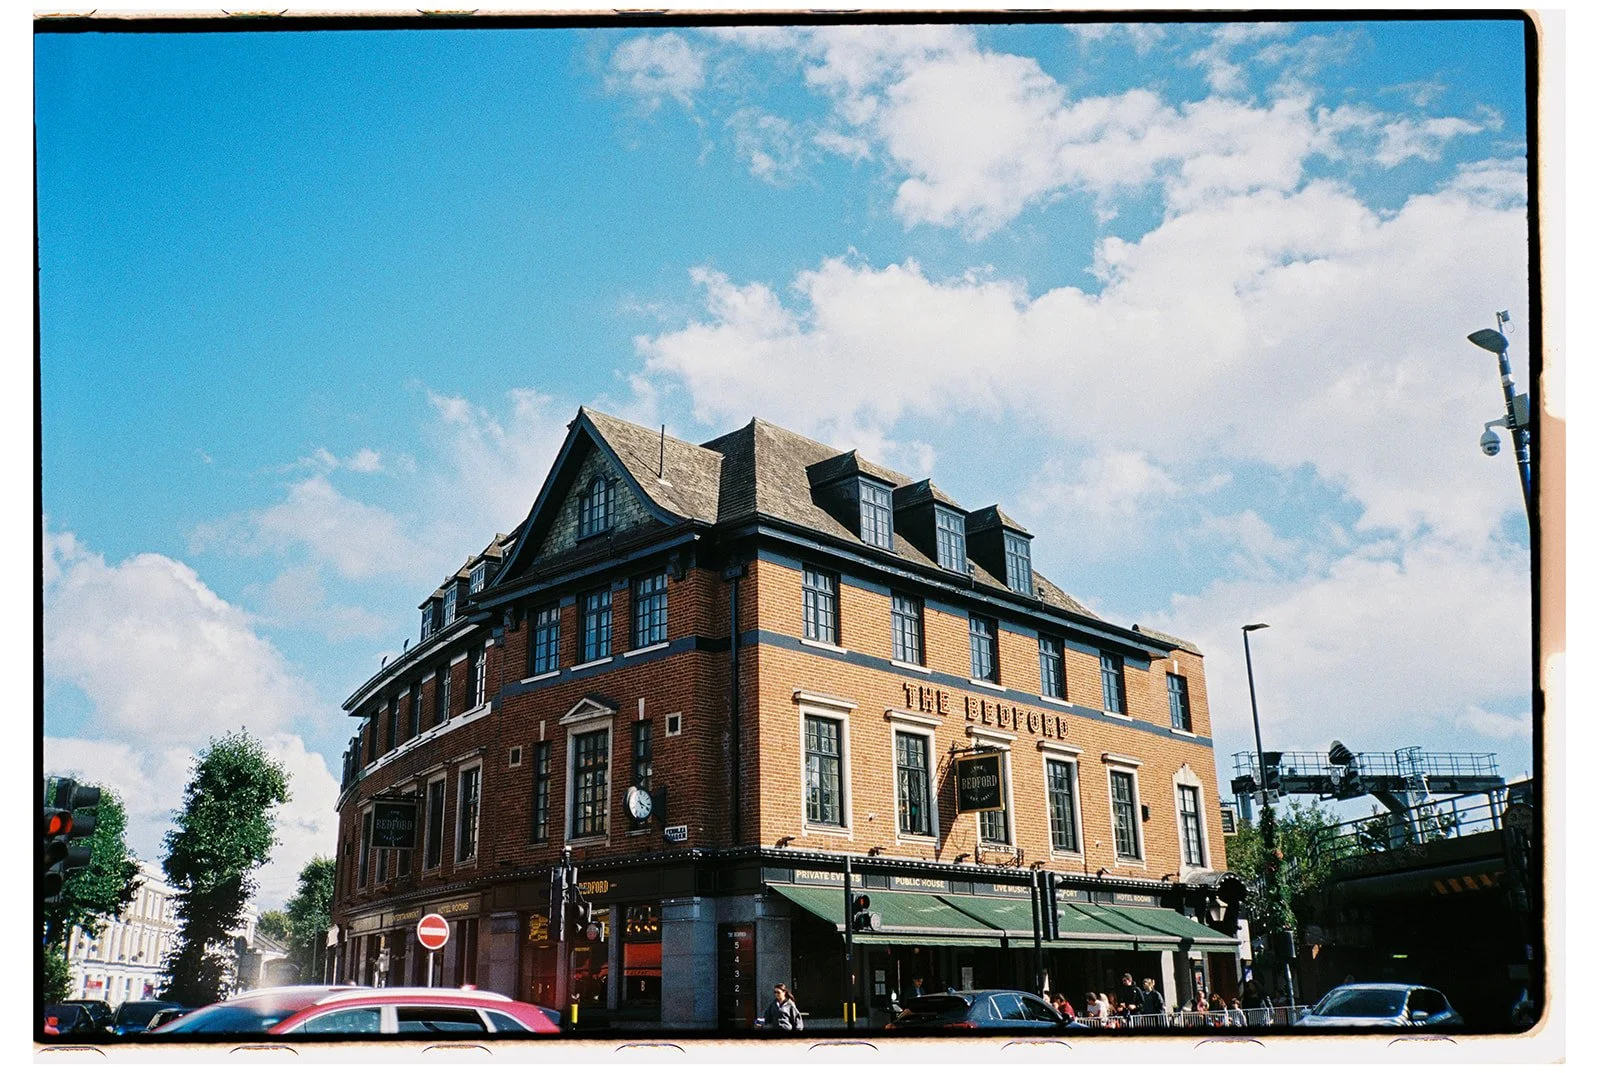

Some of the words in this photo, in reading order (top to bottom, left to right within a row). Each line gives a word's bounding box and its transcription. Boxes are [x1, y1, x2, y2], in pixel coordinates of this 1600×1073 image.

[903, 682, 950, 716] THE
[965, 696, 1069, 738] BEDFORD
[961, 775, 997, 790] BEDFORD
[376, 819, 413, 831] BEDFORD
[796, 870, 830, 881] PRIVATE
[830, 871, 861, 883] EVETS
[895, 876, 920, 887] PUBLIC
[921, 878, 945, 889] HOUSE
[578, 880, 609, 895] BEDFORD
[993, 884, 1008, 893] LIVE
[1116, 894, 1133, 902] HOTEL
[1133, 895, 1152, 903] ROOMS
[437, 904, 452, 914] HOTEL
[452, 902, 469, 912] ROOMS
